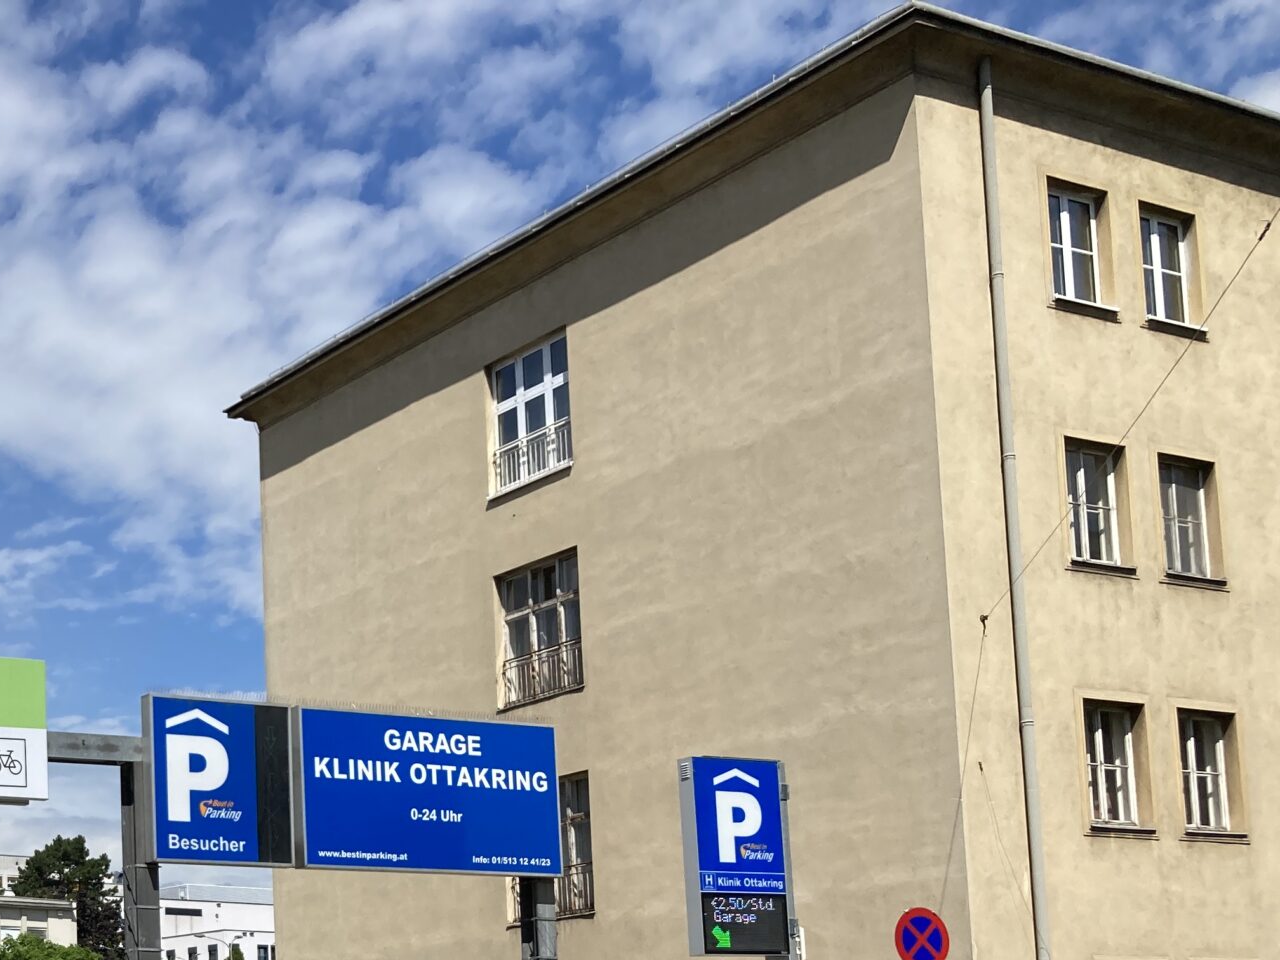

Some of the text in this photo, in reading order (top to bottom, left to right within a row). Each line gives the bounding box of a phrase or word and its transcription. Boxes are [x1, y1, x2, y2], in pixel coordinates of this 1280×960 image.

[384, 729, 482, 757] GARAGE
[166, 733, 230, 823] P
[314, 756, 549, 793] KLINIK OTTAKRING
[203, 806, 242, 822] Parking
[410, 808, 463, 823] 0-24 Uhr
[715, 790, 763, 864] P
[168, 833, 246, 854] Besucher
[318, 849, 408, 863] www.bestinparking.at
[472, 855, 551, 867] Info: 01/513 12 41/23
[744, 849, 774, 863] Parking
[705, 873, 784, 890] H Klinik Ottakring
[713, 910, 757, 924] Garage
